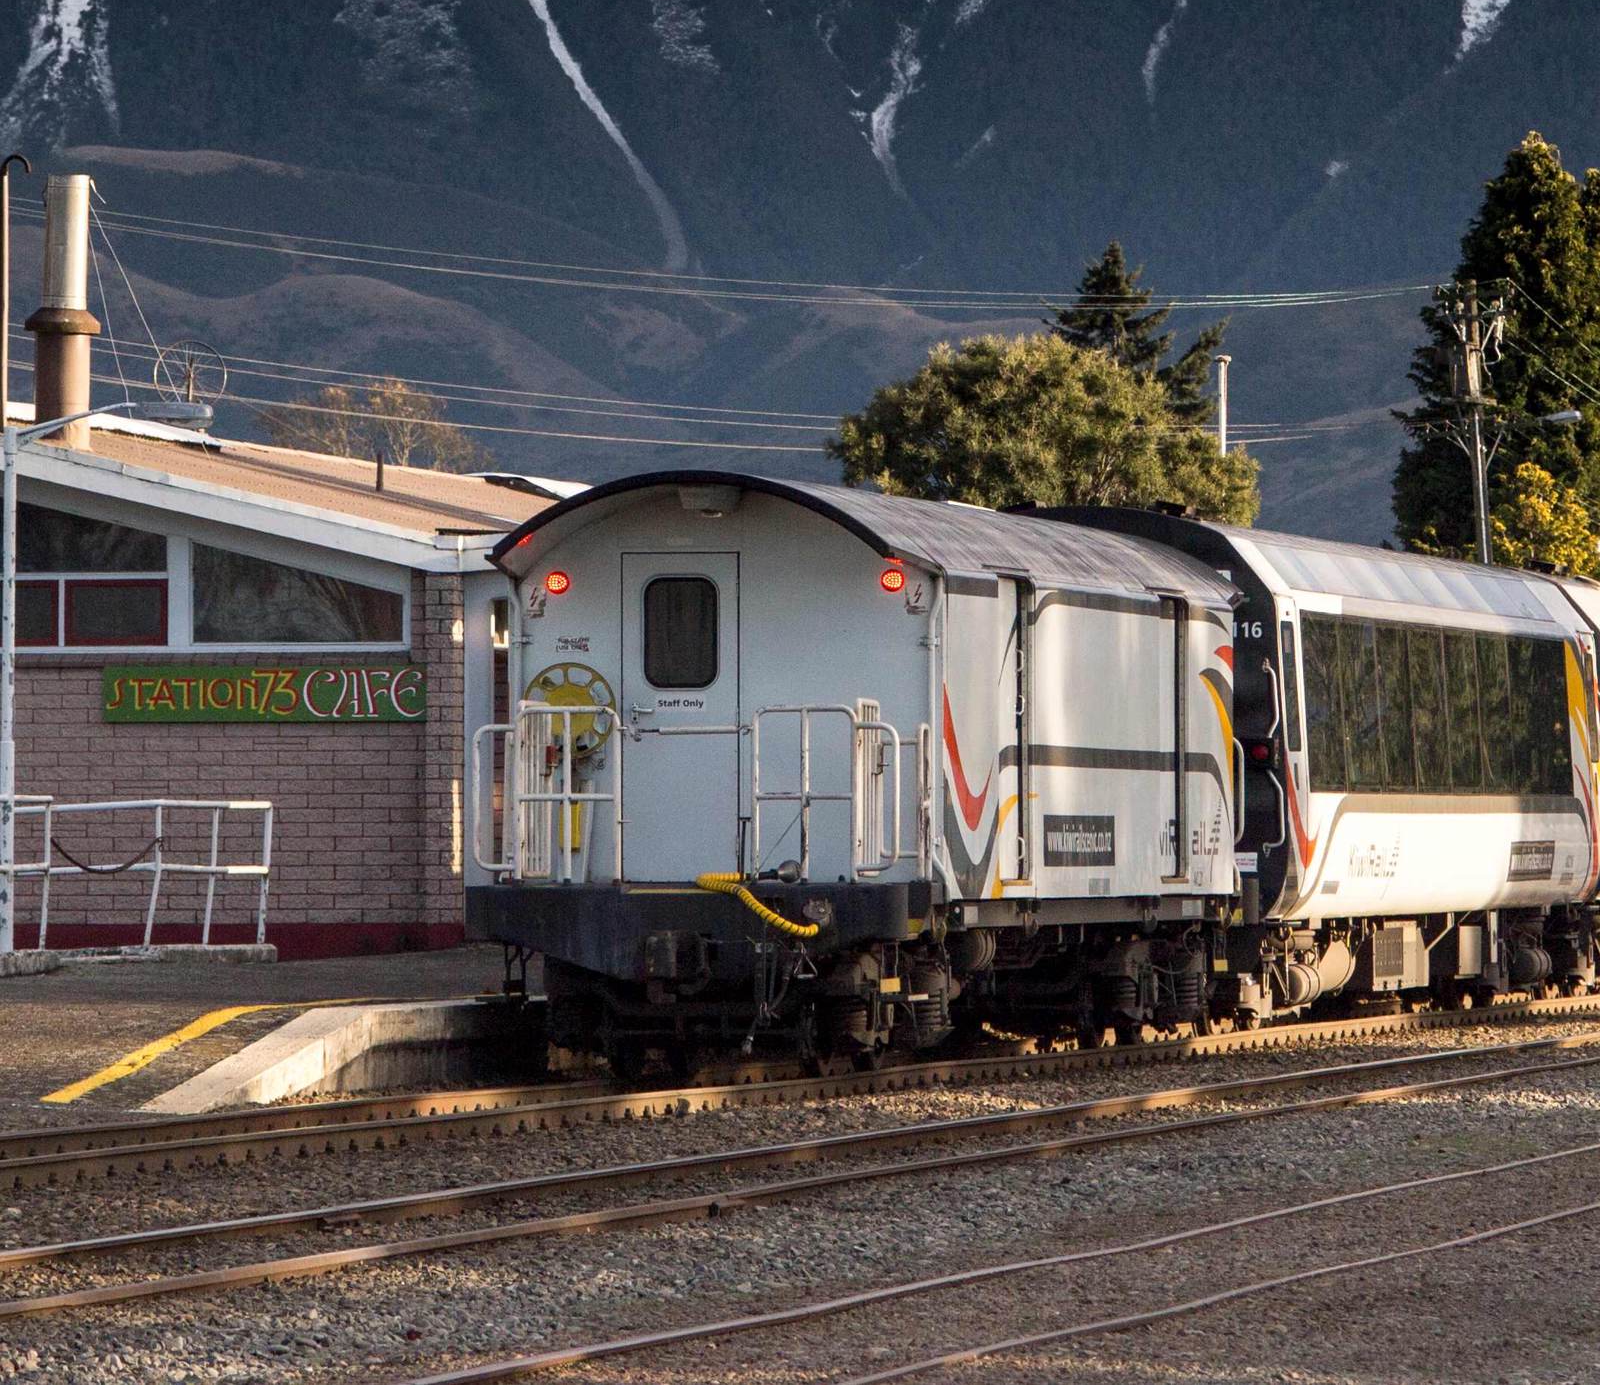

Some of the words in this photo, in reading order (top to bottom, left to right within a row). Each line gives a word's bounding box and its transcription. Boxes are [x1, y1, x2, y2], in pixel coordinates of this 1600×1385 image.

[303, 669, 424, 717] CAFE
[658, 699, 680, 707] Staff
[682, 699, 704, 708] Only
